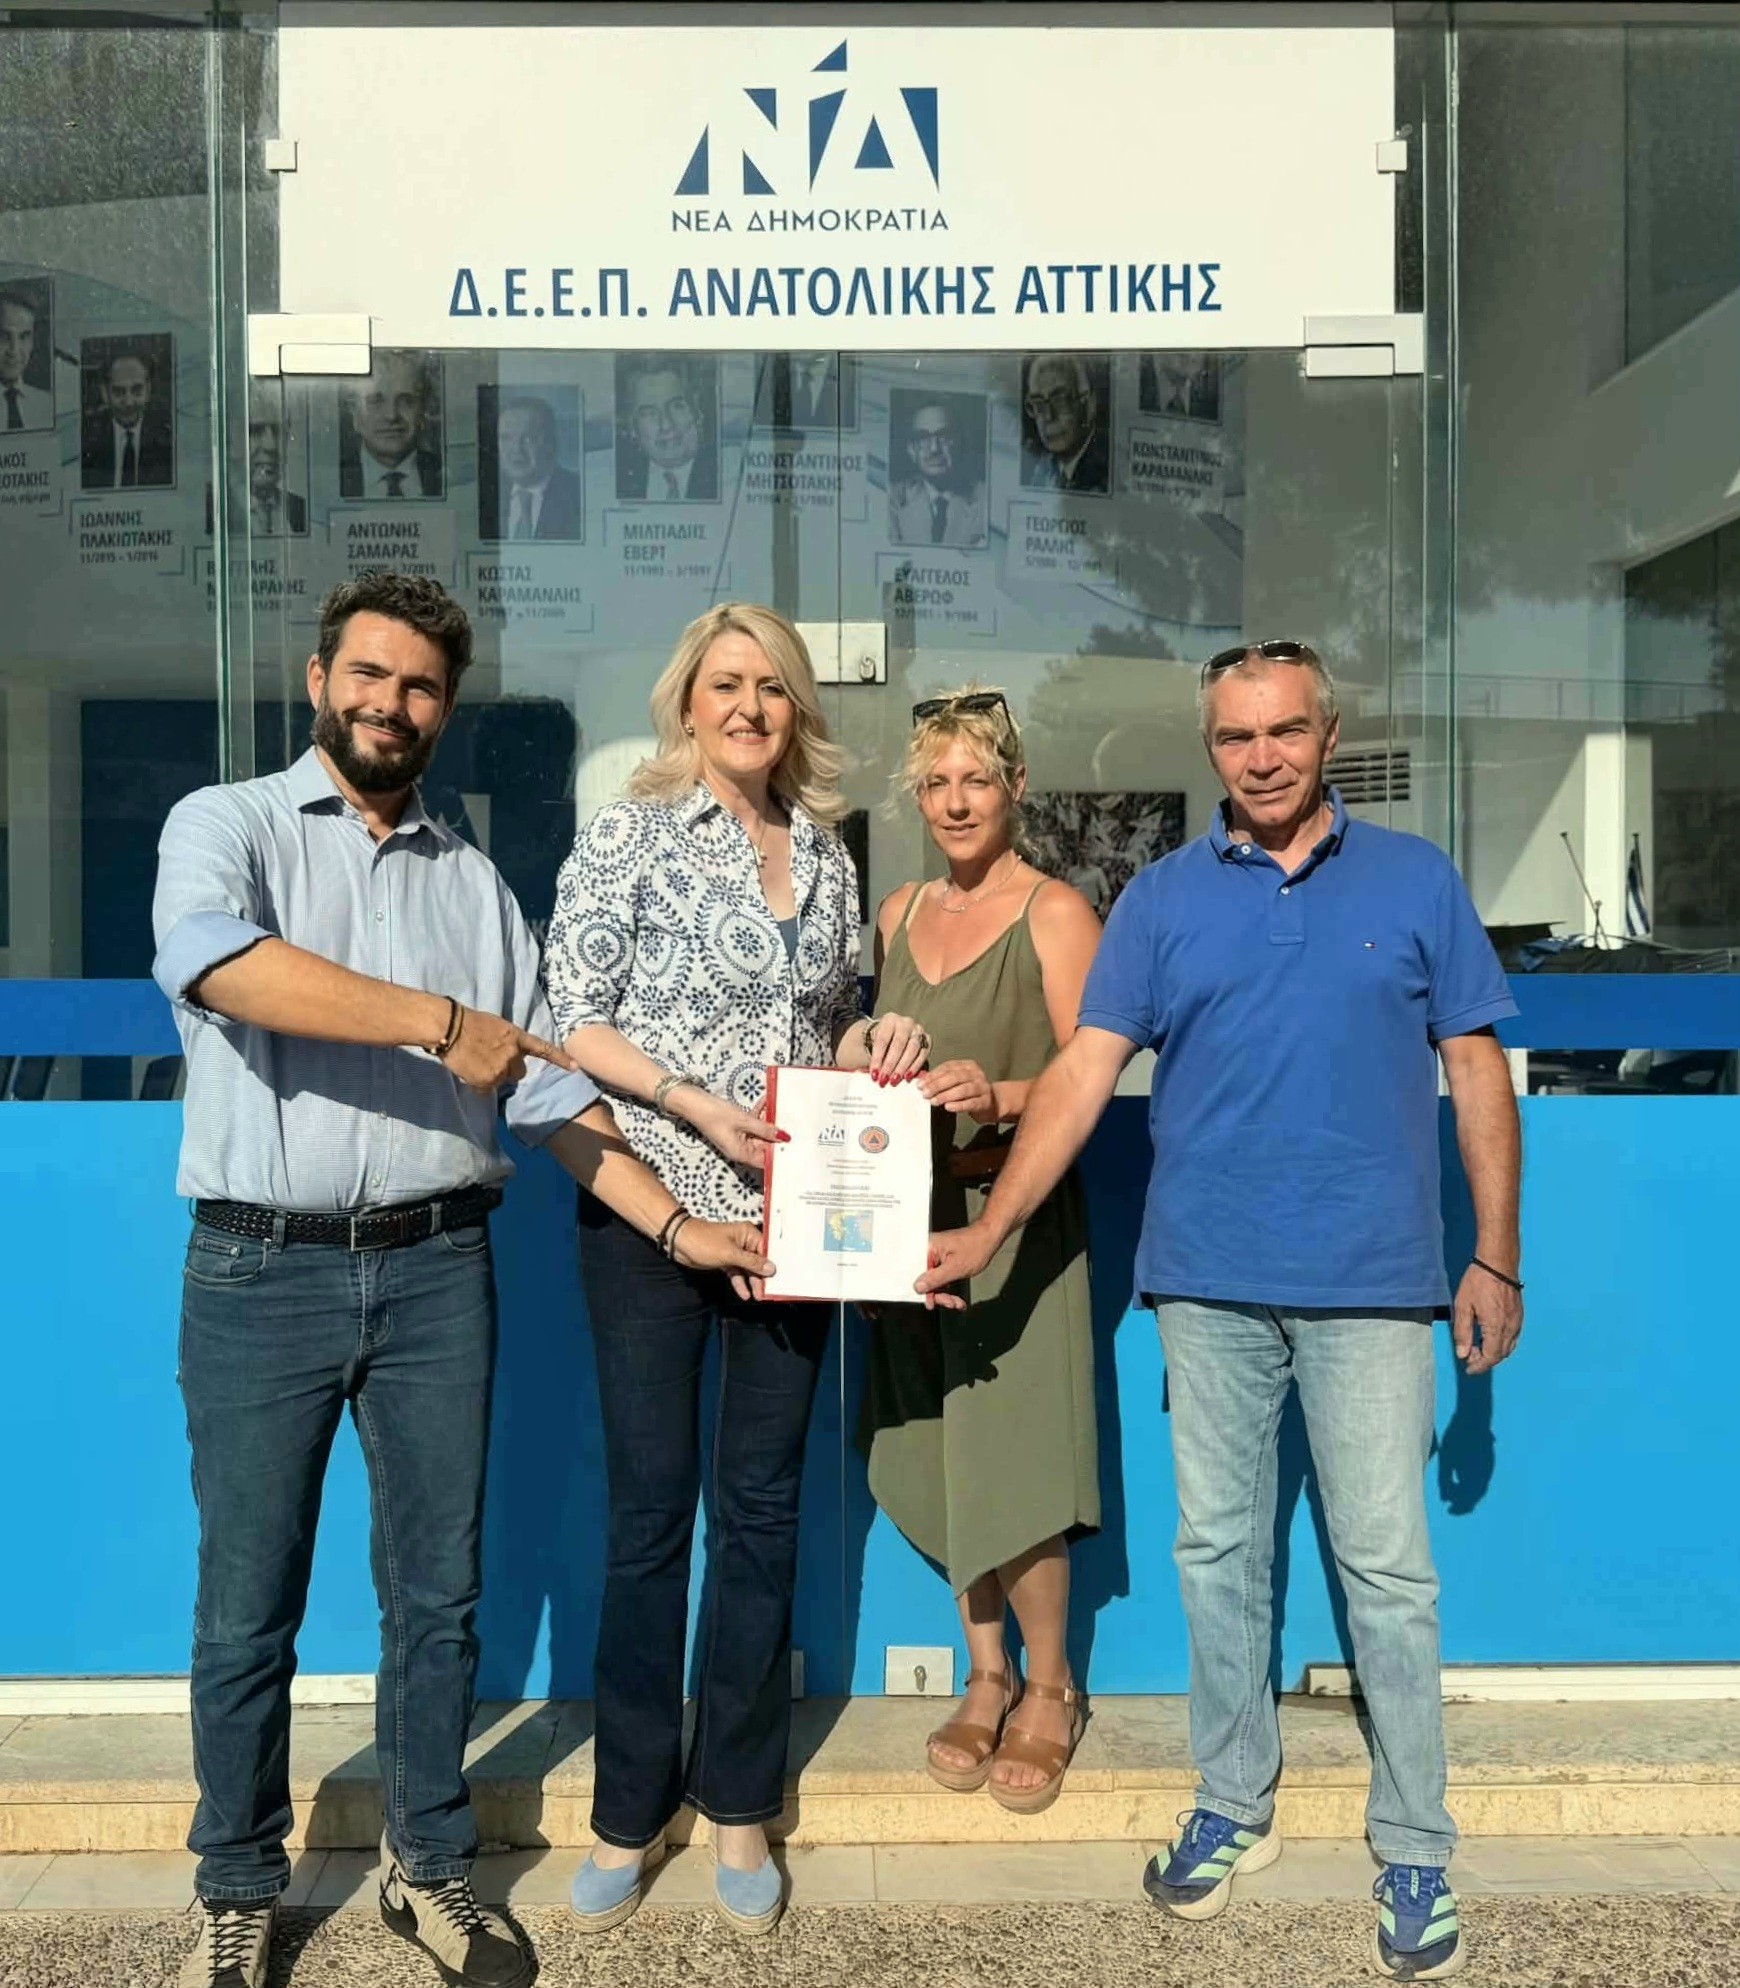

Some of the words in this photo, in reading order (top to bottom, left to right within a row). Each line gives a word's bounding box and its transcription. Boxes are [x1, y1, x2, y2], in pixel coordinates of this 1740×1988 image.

[673, 210, 731, 232] ΝΕΑ
[747, 208, 948, 232] ΔΗΜΟΚΡΑΤΙΑ
[449, 268, 648, 317] Δ.Ε.Ε.Π.
[668, 266, 996, 317] ΑΝΑΤΟΛΙΚΗΣ
[1015, 263, 1222, 314] ΑΤΤΙΚΗΣ
[80, 510, 143, 528] ΙΩΑΝΝΗΣ
[80, 529, 173, 548] ΠΛΑΚΙΩΤΑΚΗΣ
[347, 522, 421, 539] ΑΝΤΩΝΗΣ
[623, 523, 707, 540] ΜΙΛΤΙΑΔΗΣ
[347, 542, 419, 559] ΣΑΜΑΡΑΣ
[623, 545, 666, 561] ΕΒΕΡΤ
[478, 565, 532, 582] ΚΩΣΤΑΣ
[895, 567, 971, 586] ΕΥΑΓΓΕΛΟΣ
[478, 587, 581, 604] ΚΑΡΑΜΑΝΛΗΣ
[895, 588, 954, 605] ΑΒΕΡΩΦ
